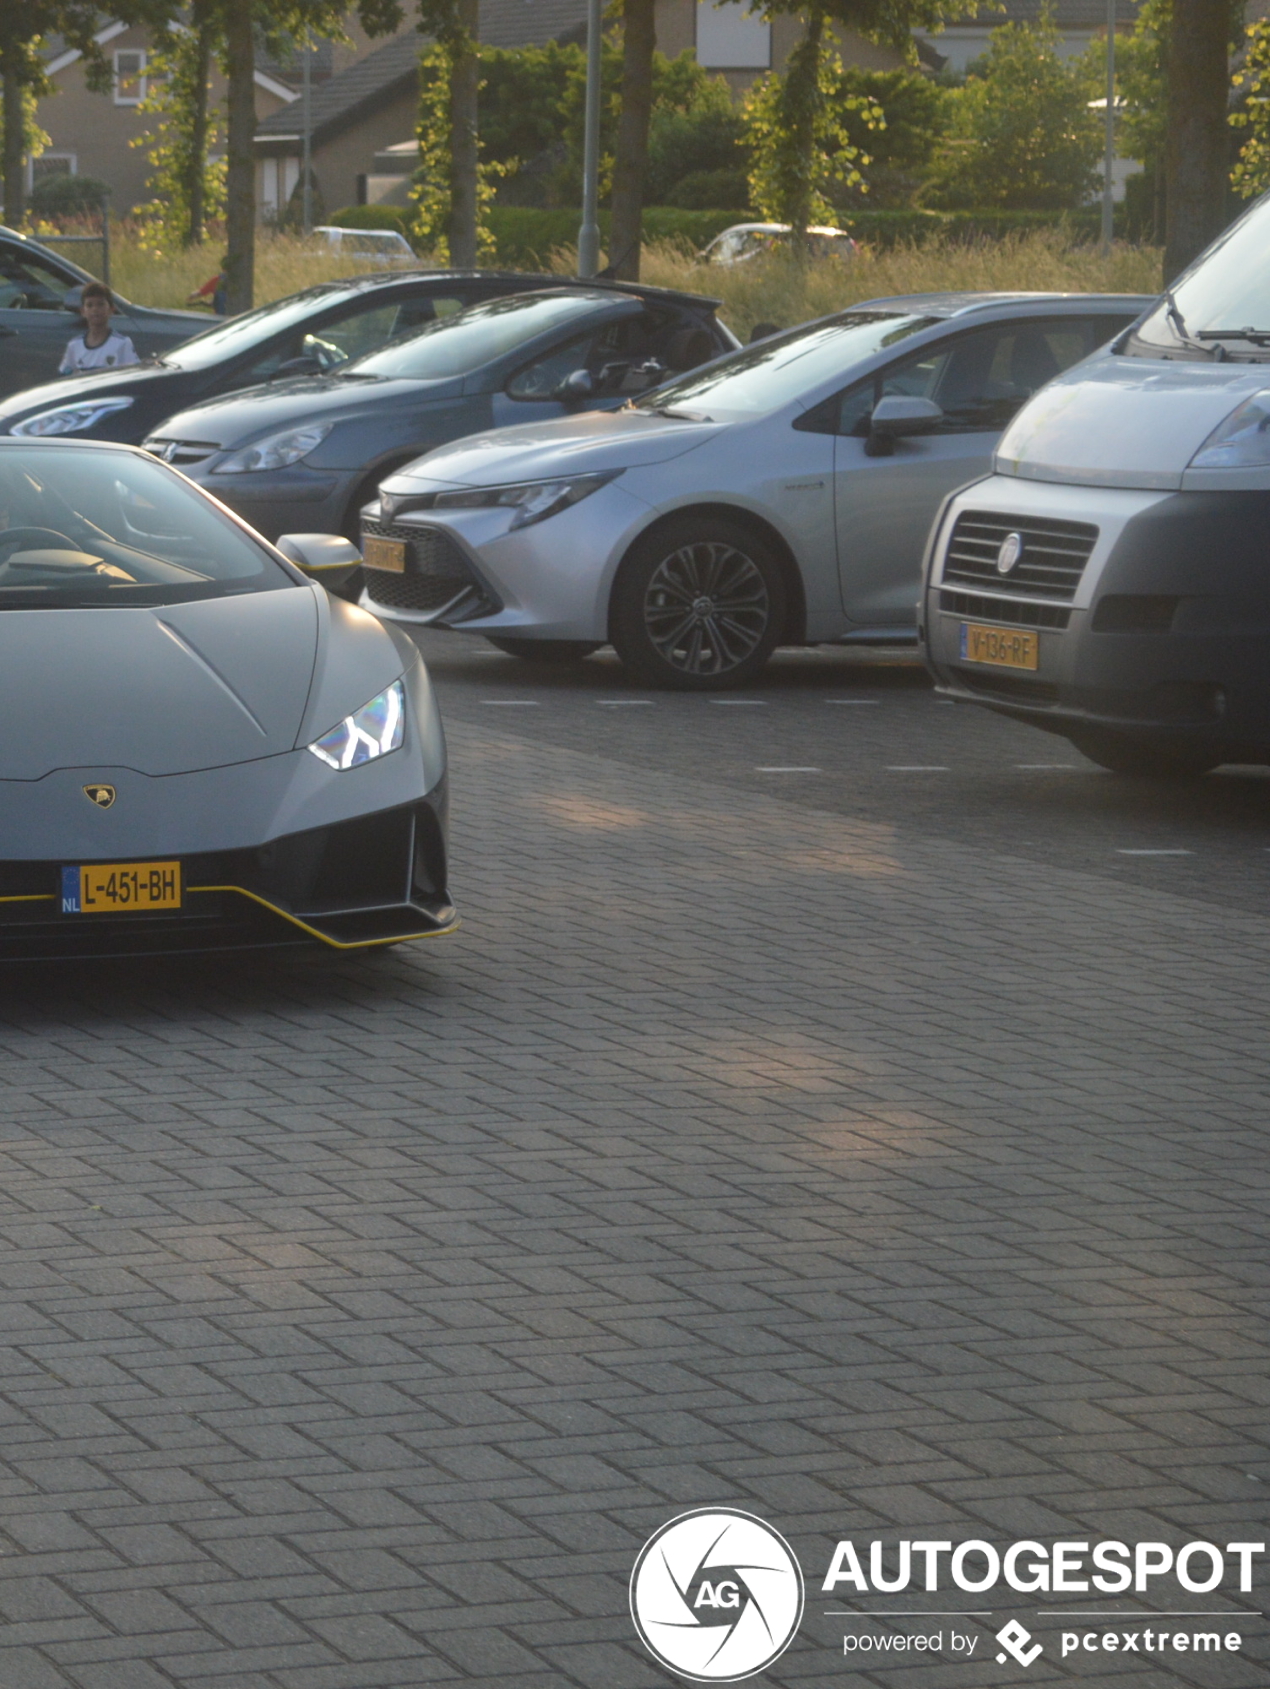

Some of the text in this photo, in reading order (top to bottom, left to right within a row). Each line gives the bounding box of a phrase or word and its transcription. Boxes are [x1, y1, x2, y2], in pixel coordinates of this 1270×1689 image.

[972, 630, 1030, 663] V-136-RF
[85, 870, 175, 904] L-451-BH
[63, 898, 80, 912] NL
